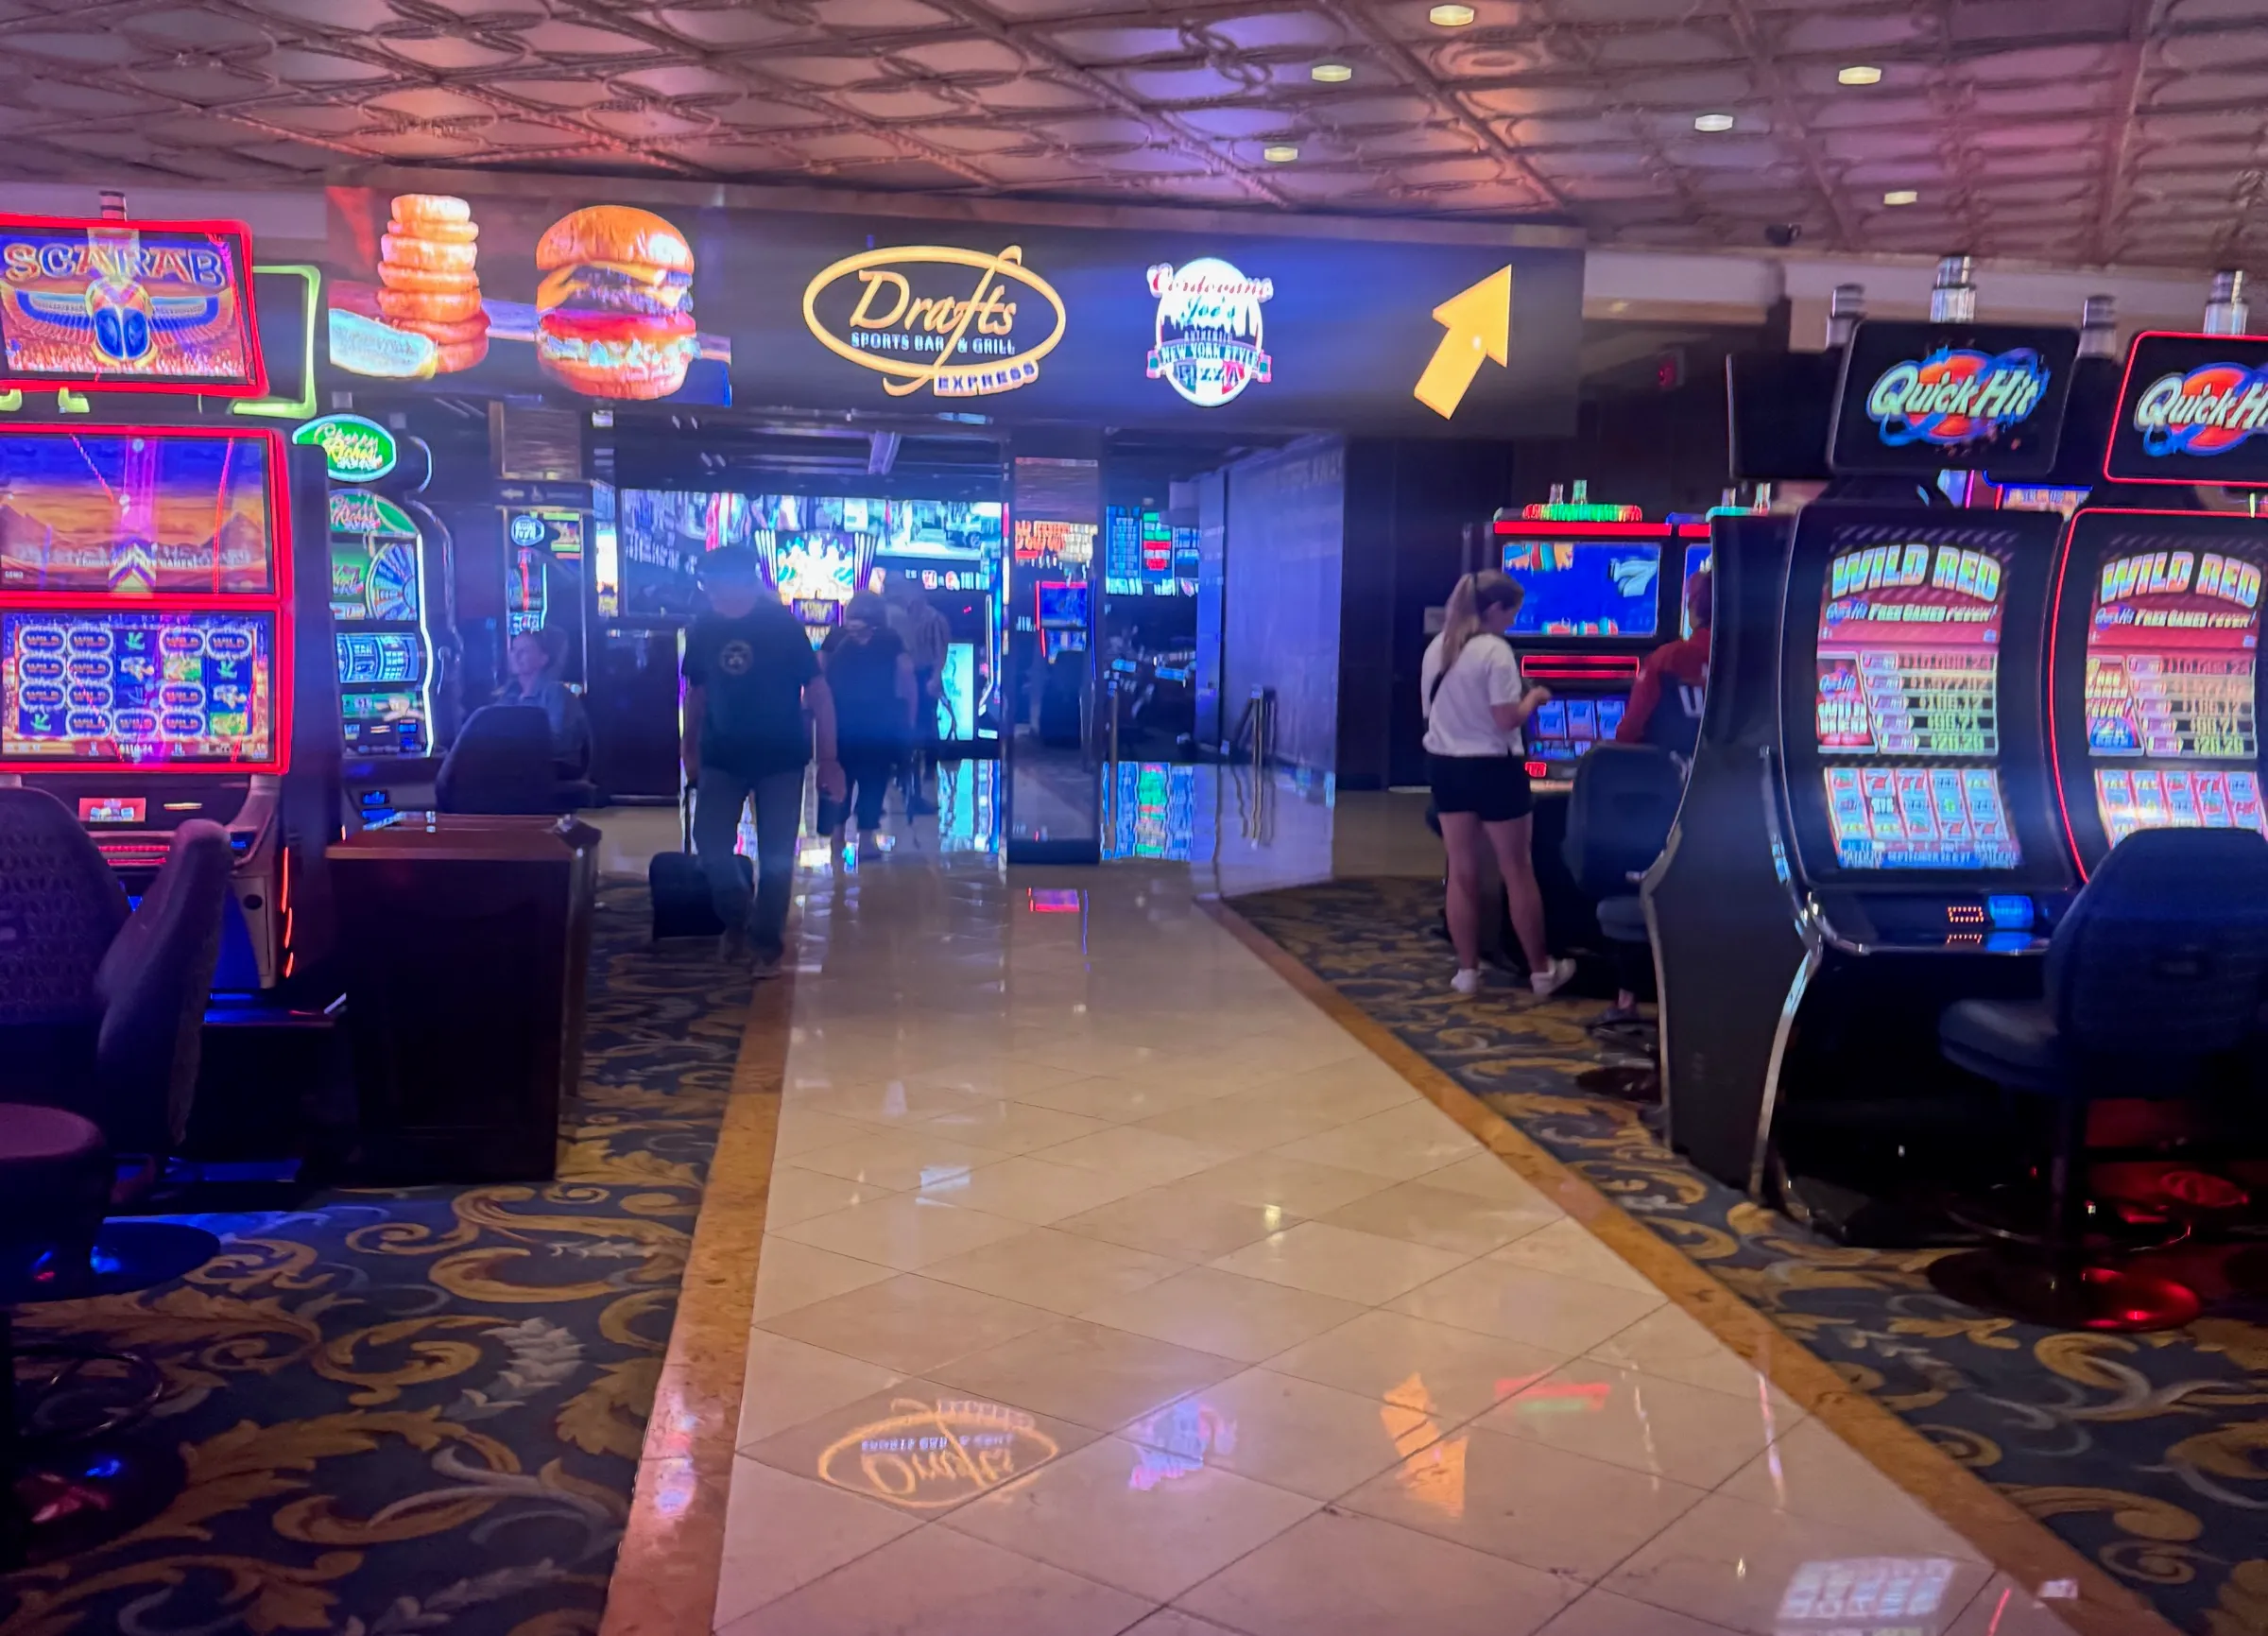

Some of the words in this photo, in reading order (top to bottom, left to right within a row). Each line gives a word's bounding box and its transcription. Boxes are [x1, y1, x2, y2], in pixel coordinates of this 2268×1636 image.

[4, 243, 226, 288] SCARAB
[850, 332, 910, 351] SPORTS
[914, 335, 944, 353] BAR
[957, 337, 968, 353] &
[972, 337, 1016, 355] GRILL
[1160, 342, 1188, 366] NEW
[1190, 340, 1222, 360] YORK
[1223, 343, 1260, 371] STYLE
[936, 360, 1038, 392] EXPRESS
[1177, 362, 1242, 387] PIZZA
[1871, 365, 1980, 416] Quick
[1968, 369, 2039, 418] Hit
[2138, 377, 2238, 427] Quick
[1831, 543, 1930, 599] WILD
[1932, 544, 2001, 602] RED
[2101, 551, 2194, 605] WILD
[2195, 552, 2261, 609] RED
